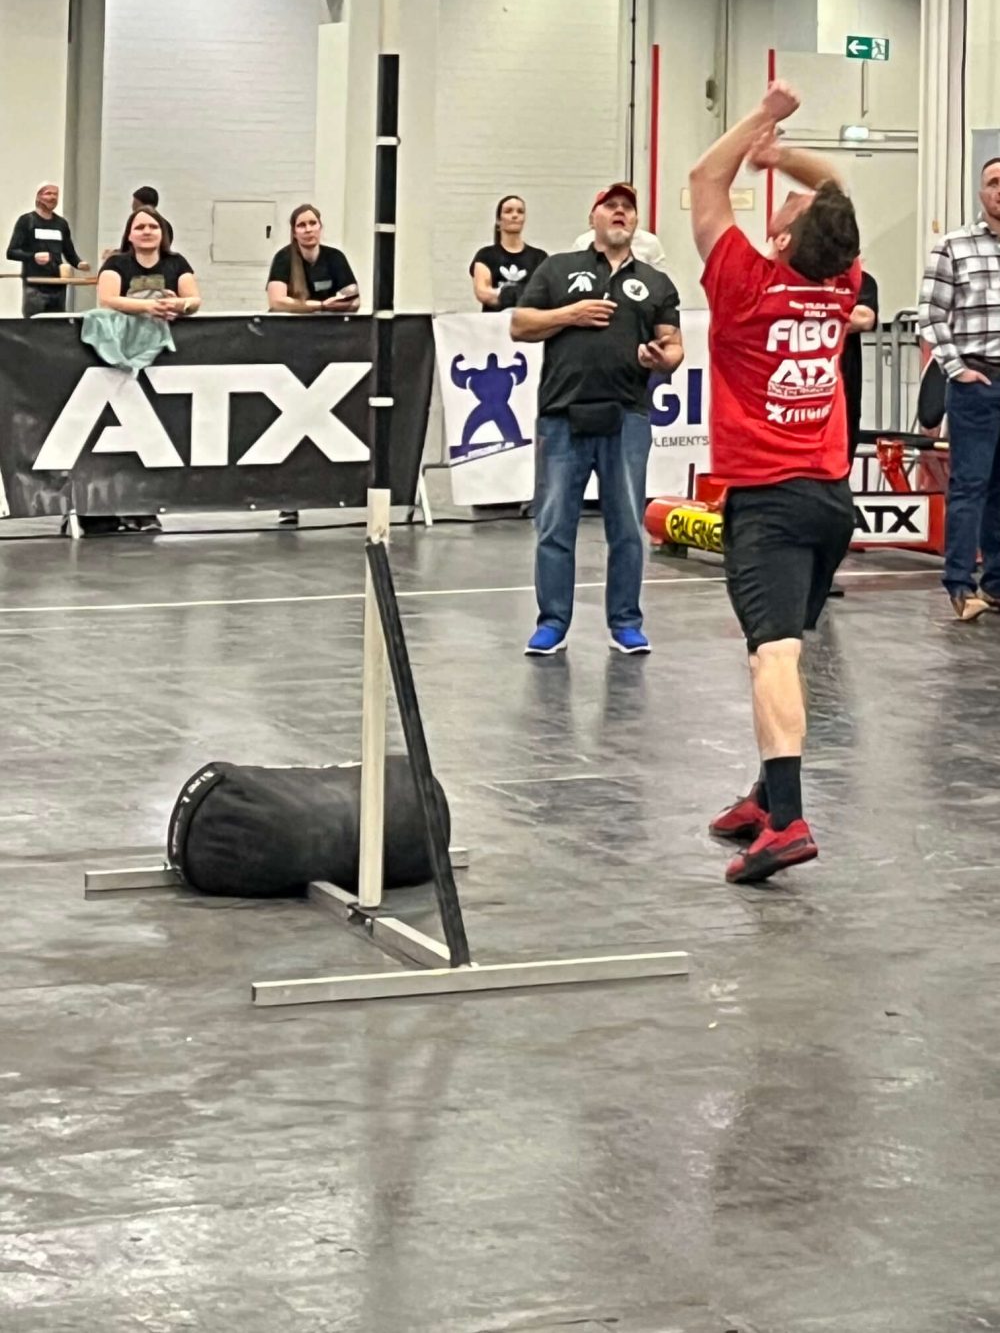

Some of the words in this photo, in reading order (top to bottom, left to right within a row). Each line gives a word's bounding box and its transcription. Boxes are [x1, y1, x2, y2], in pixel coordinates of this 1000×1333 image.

[766, 318, 842, 353] FIBO
[769, 354, 839, 388] ATX
[32, 362, 373, 470] ATX
